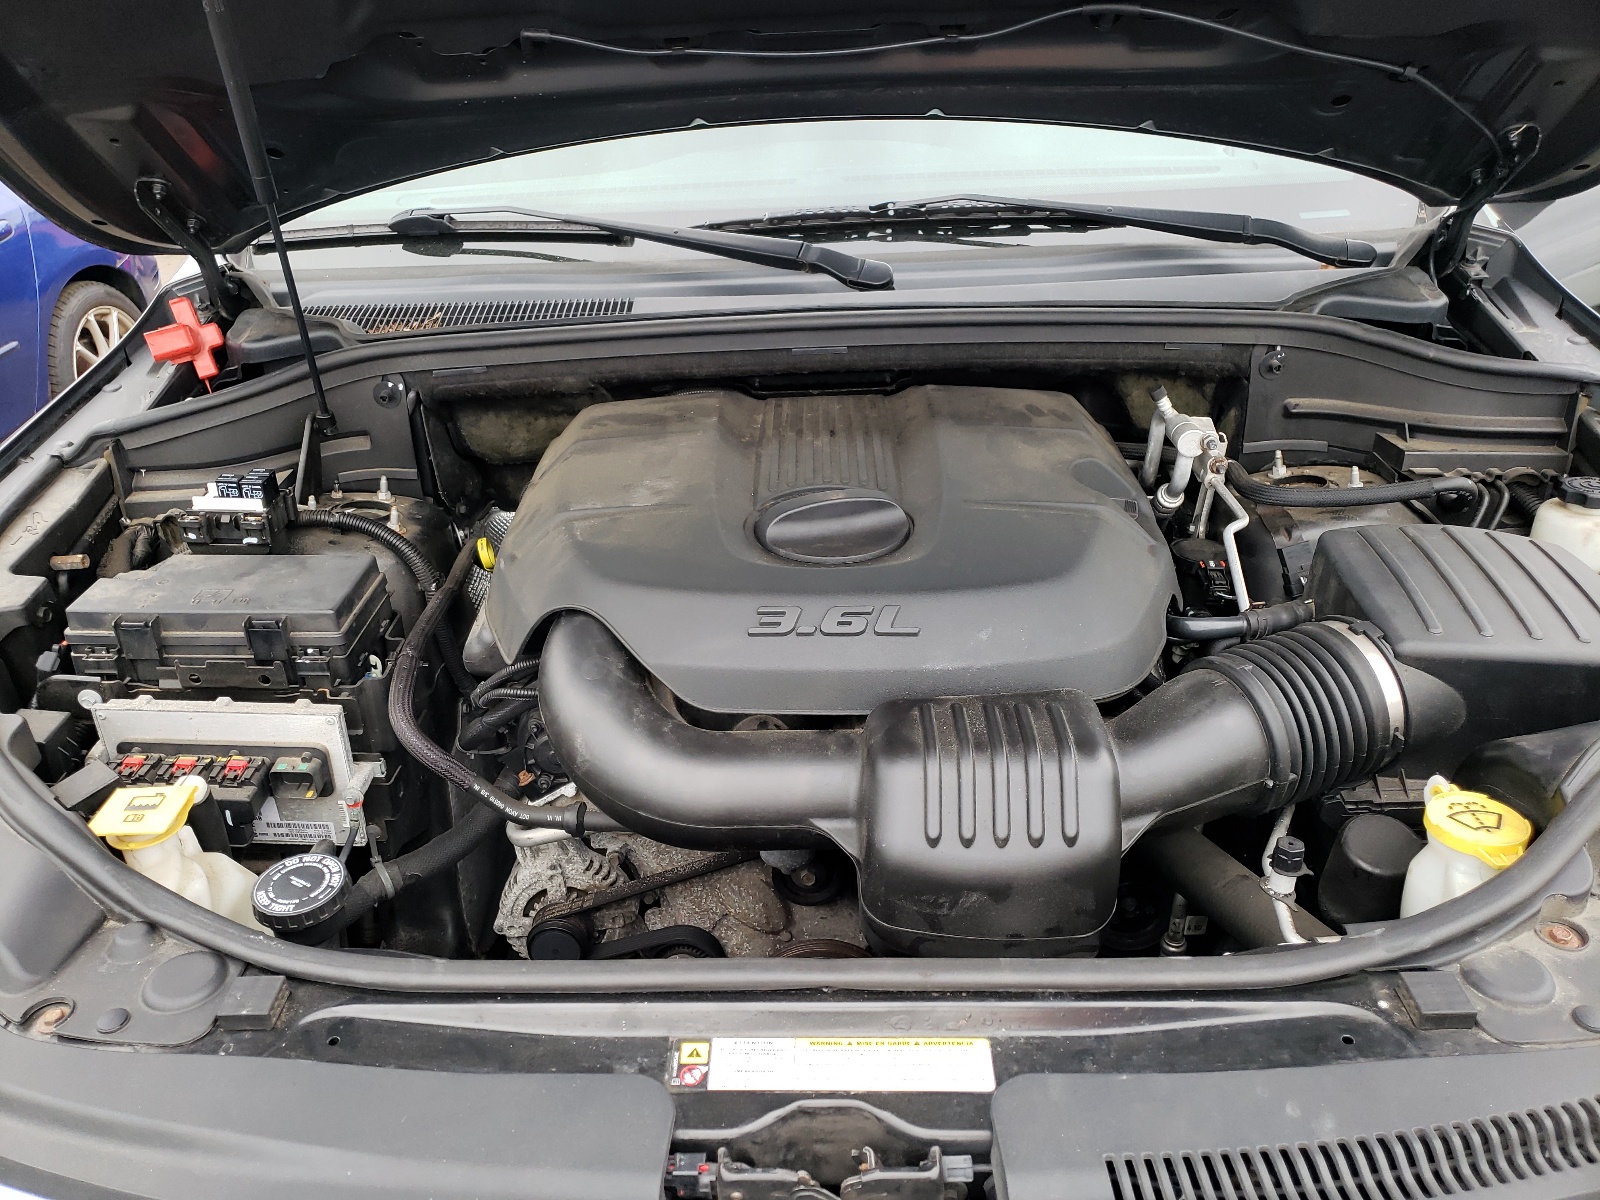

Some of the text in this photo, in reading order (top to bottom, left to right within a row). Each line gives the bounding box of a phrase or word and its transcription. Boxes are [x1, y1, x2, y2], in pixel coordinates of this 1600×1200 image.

[748, 605, 921, 637] 3.6L
[285, 858, 300, 866] DO
[302, 855, 323, 863] NOT
[322, 858, 341, 873] OPEN
[328, 873, 342, 888] HOT
[256, 890, 271, 906] KEEP
[269, 903, 296, 912] TIGHT
